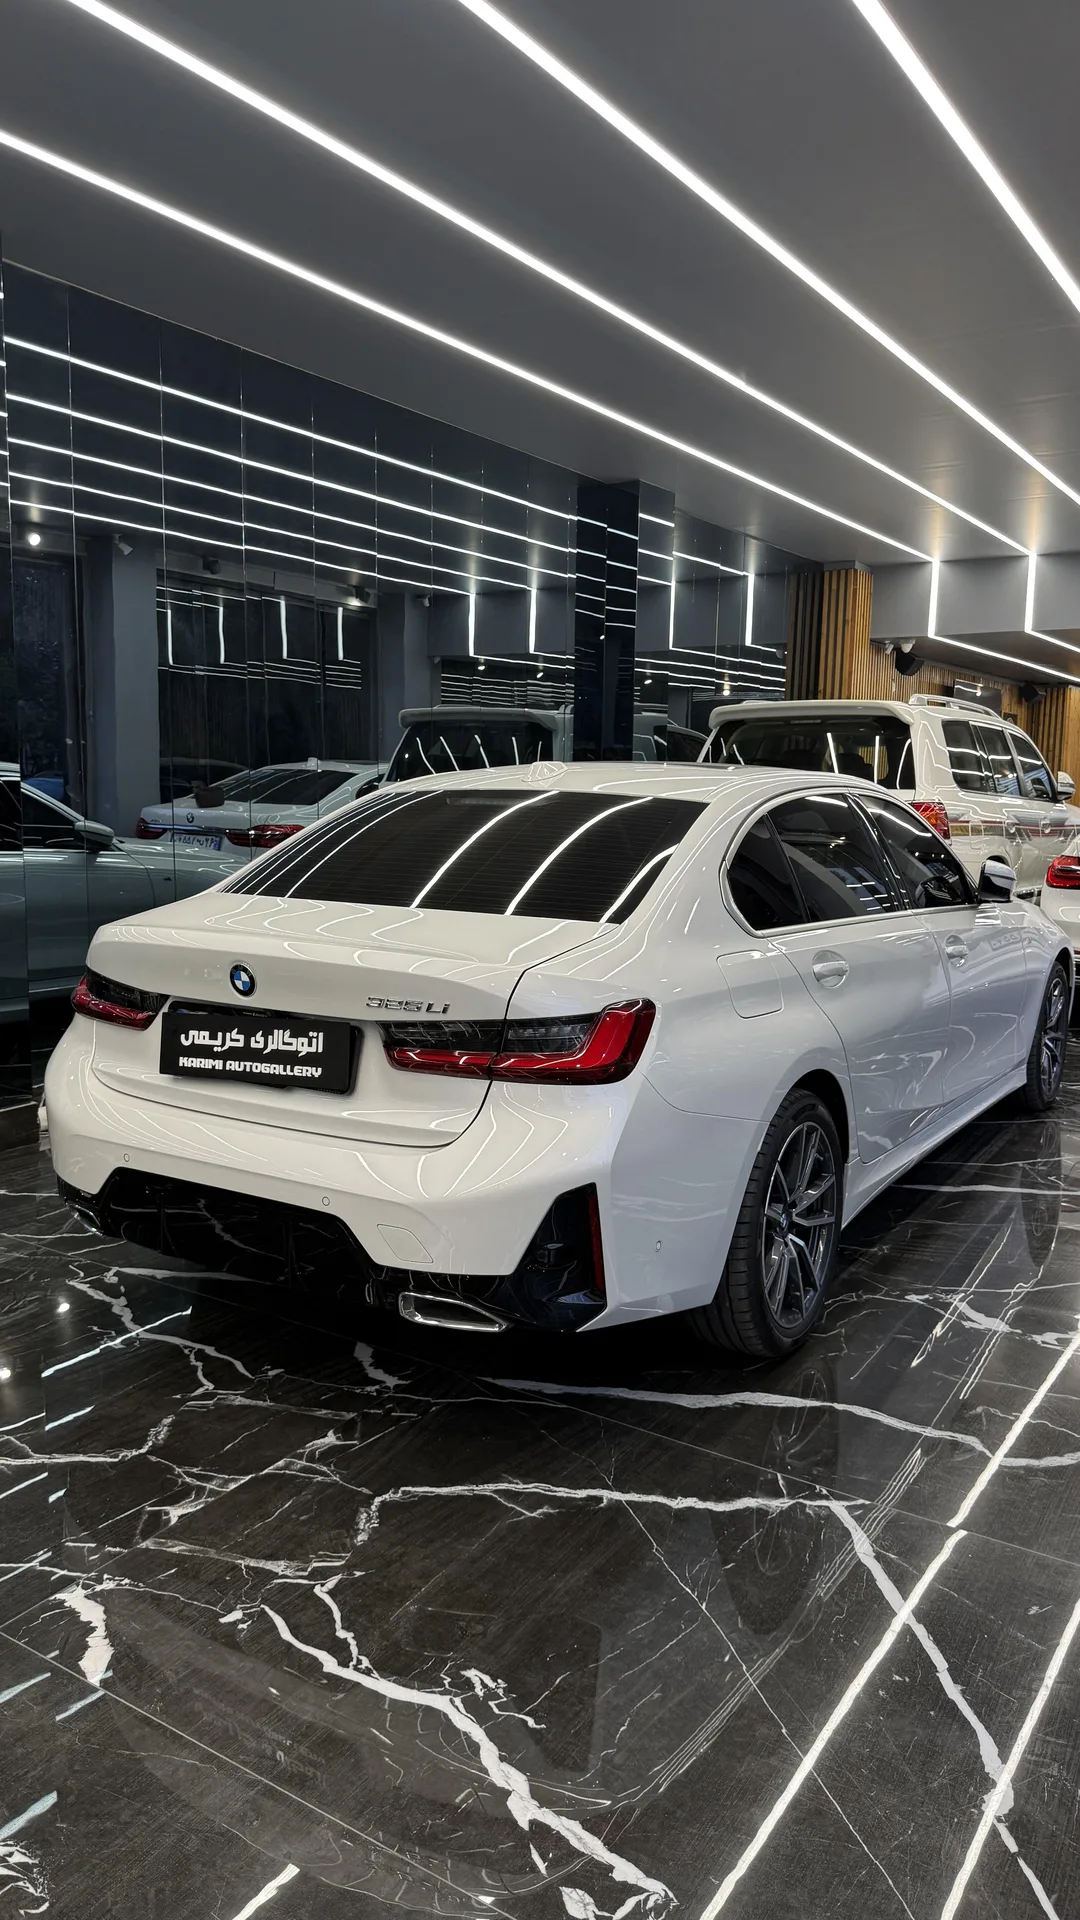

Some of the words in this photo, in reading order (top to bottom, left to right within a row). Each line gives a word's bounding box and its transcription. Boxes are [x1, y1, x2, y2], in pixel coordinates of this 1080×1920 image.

[181, 1028, 244, 1052] کریمی
[251, 1029, 323, 1056] اتوگالری
[179, 1057, 223, 1069] KARIMI
[226, 1061, 322, 1077] AUTOGALLERY
